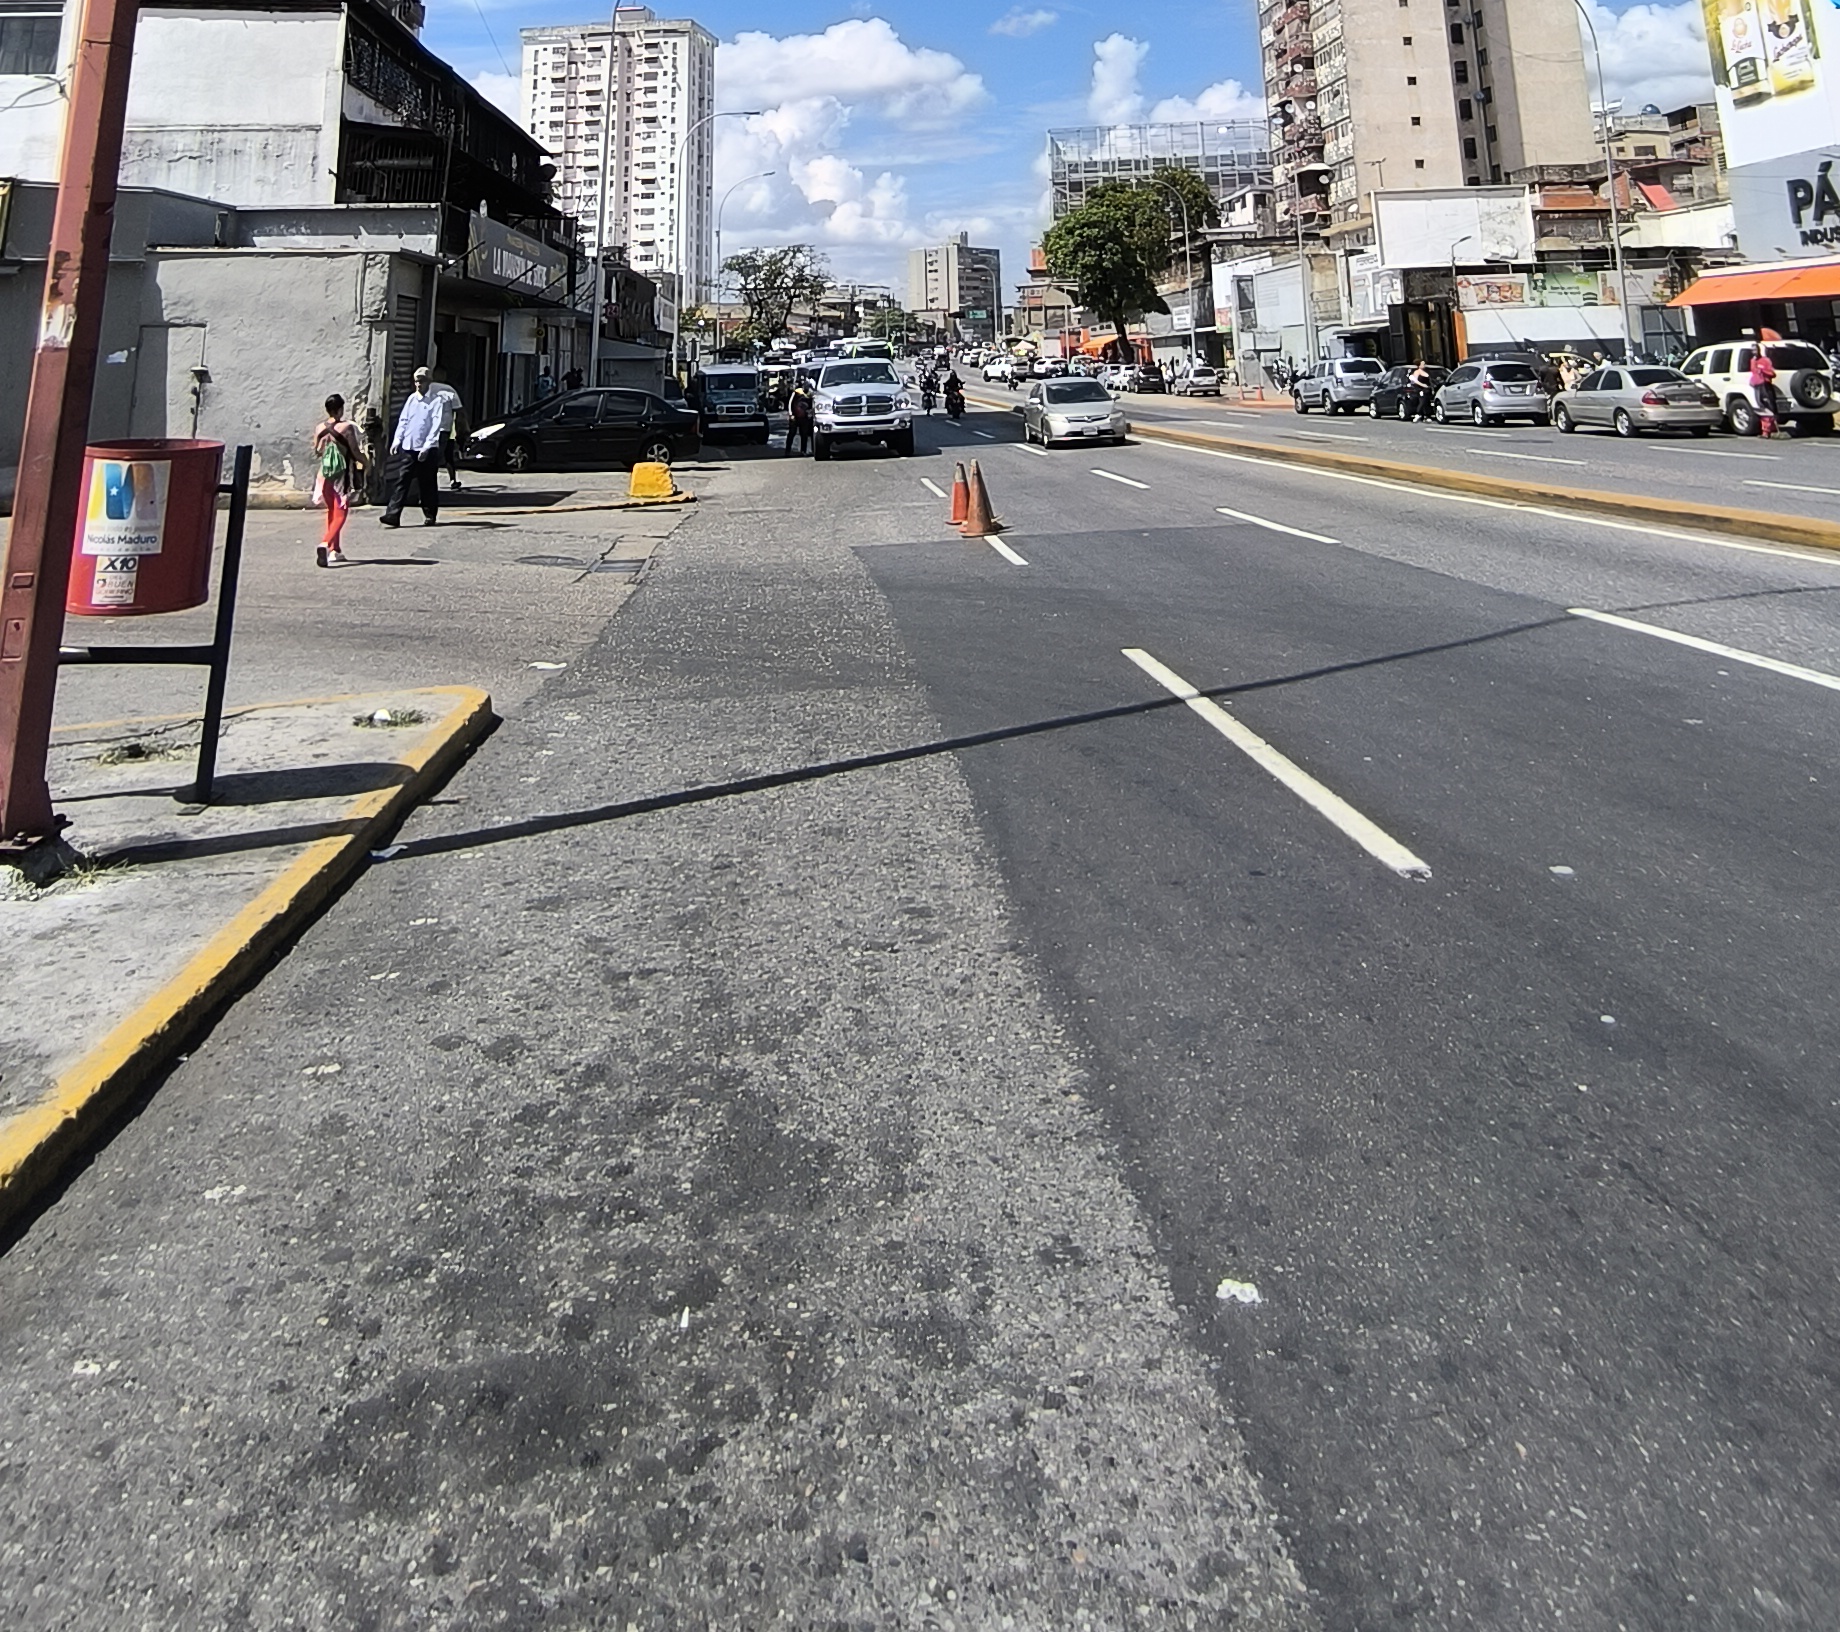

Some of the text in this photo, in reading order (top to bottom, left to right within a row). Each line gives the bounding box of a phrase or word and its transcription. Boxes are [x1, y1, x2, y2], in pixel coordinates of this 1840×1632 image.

[493, 247, 501, 275] LA
[87, 533, 158, 544] Nicolás Maduro
[102, 557, 137, 571] X10
